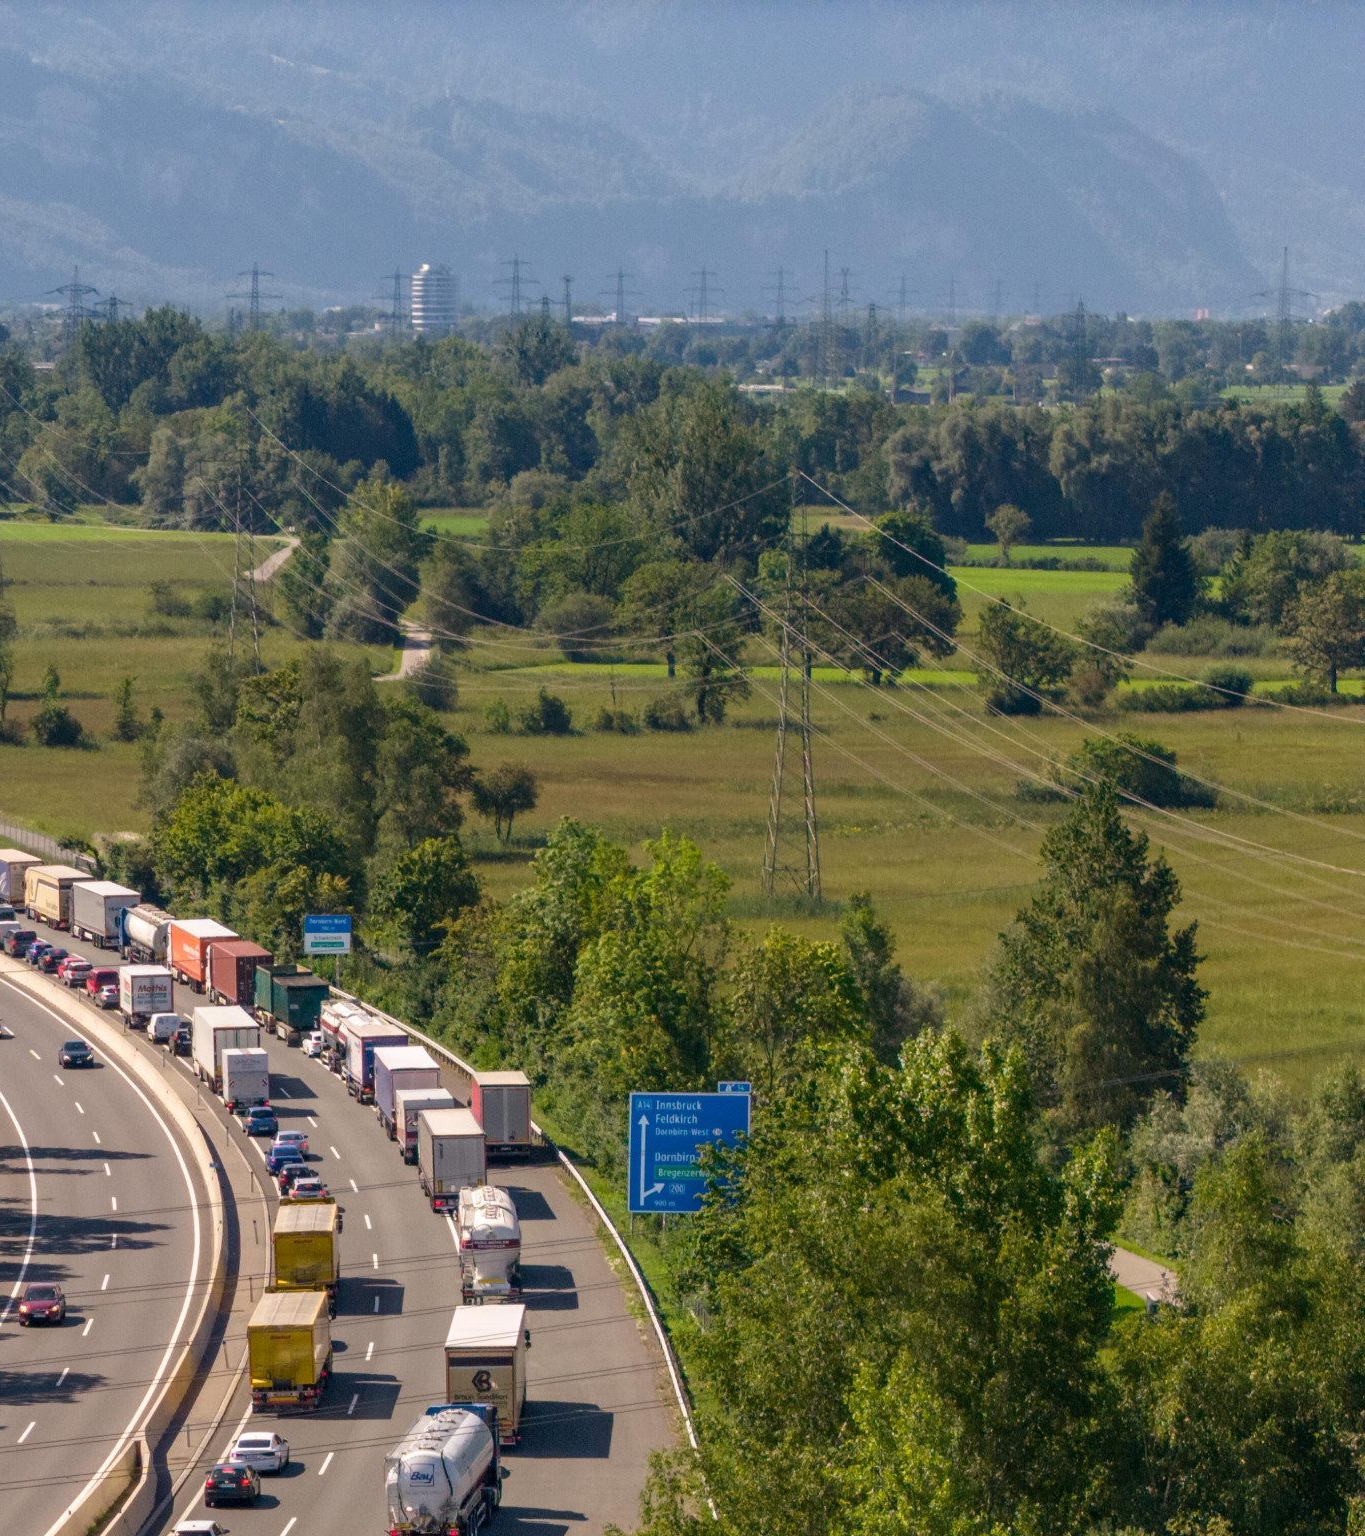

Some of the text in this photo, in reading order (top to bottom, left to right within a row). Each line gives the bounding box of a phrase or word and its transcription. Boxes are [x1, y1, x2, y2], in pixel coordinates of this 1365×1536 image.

[138, 984, 167, 992] Mathis
[637, 1100, 702, 1110] A14 Innsbruck
[655, 1113, 698, 1124] Feldkirch
[670, 1184, 684, 1193] 200
